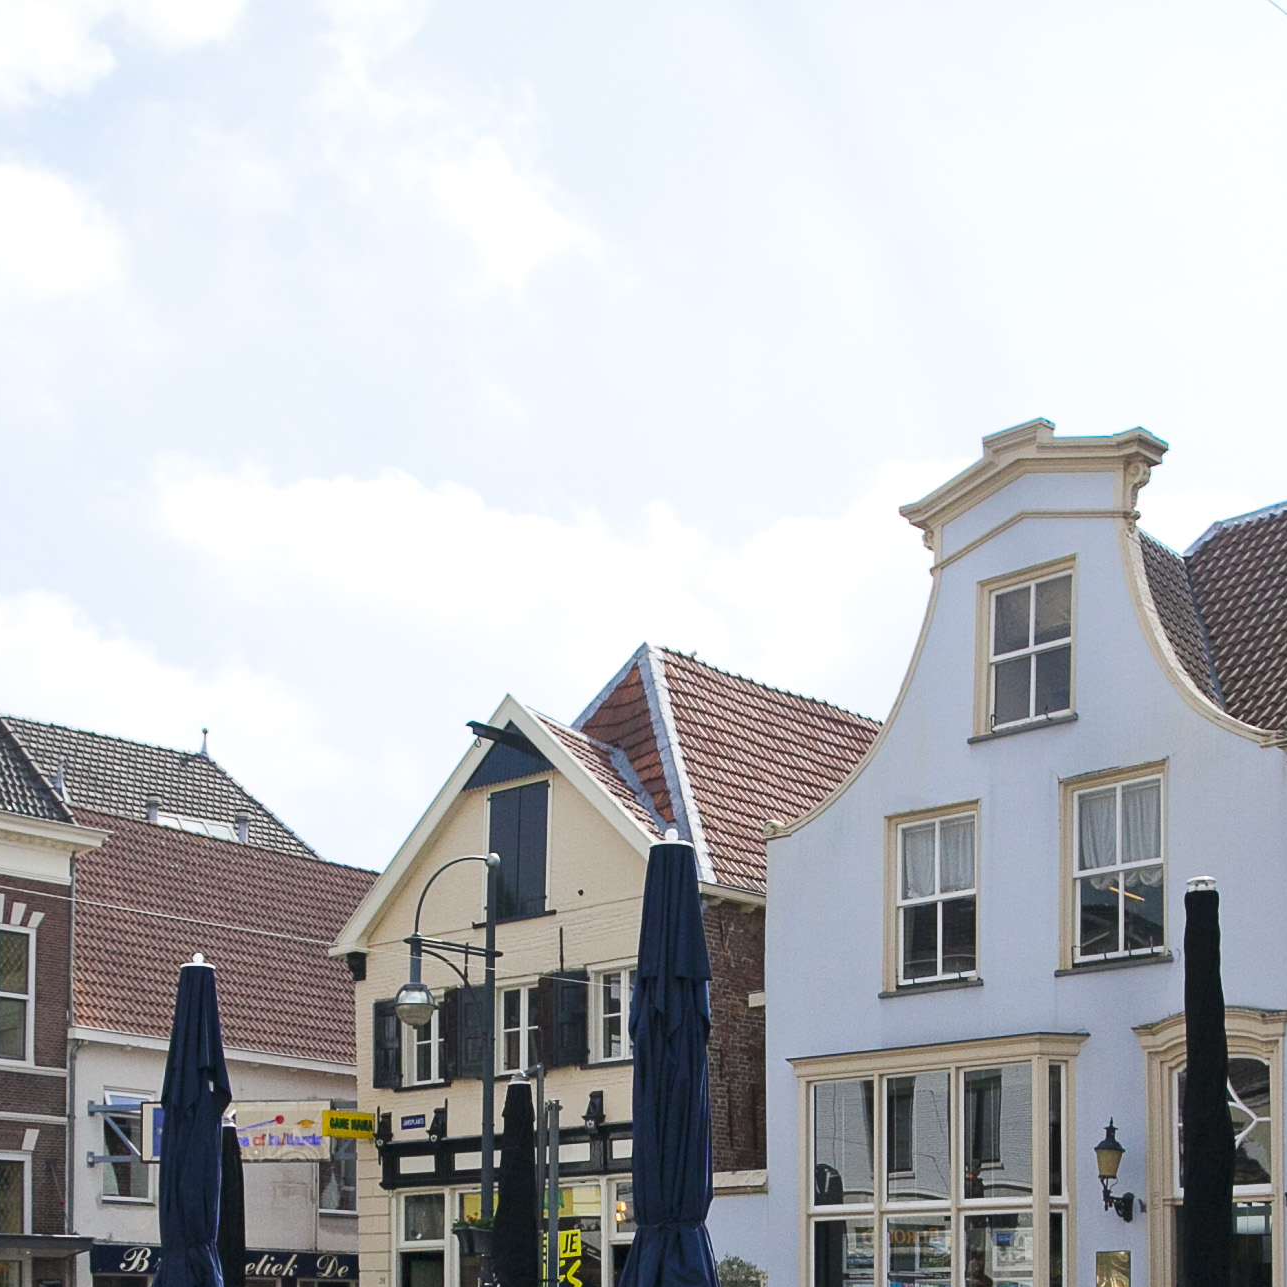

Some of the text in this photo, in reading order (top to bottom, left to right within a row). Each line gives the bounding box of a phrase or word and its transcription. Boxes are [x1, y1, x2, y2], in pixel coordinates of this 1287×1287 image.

[329, 1117, 350, 1130] GAME
[562, 1233, 579, 1253] JE
[316, 1254, 349, 1278] De
